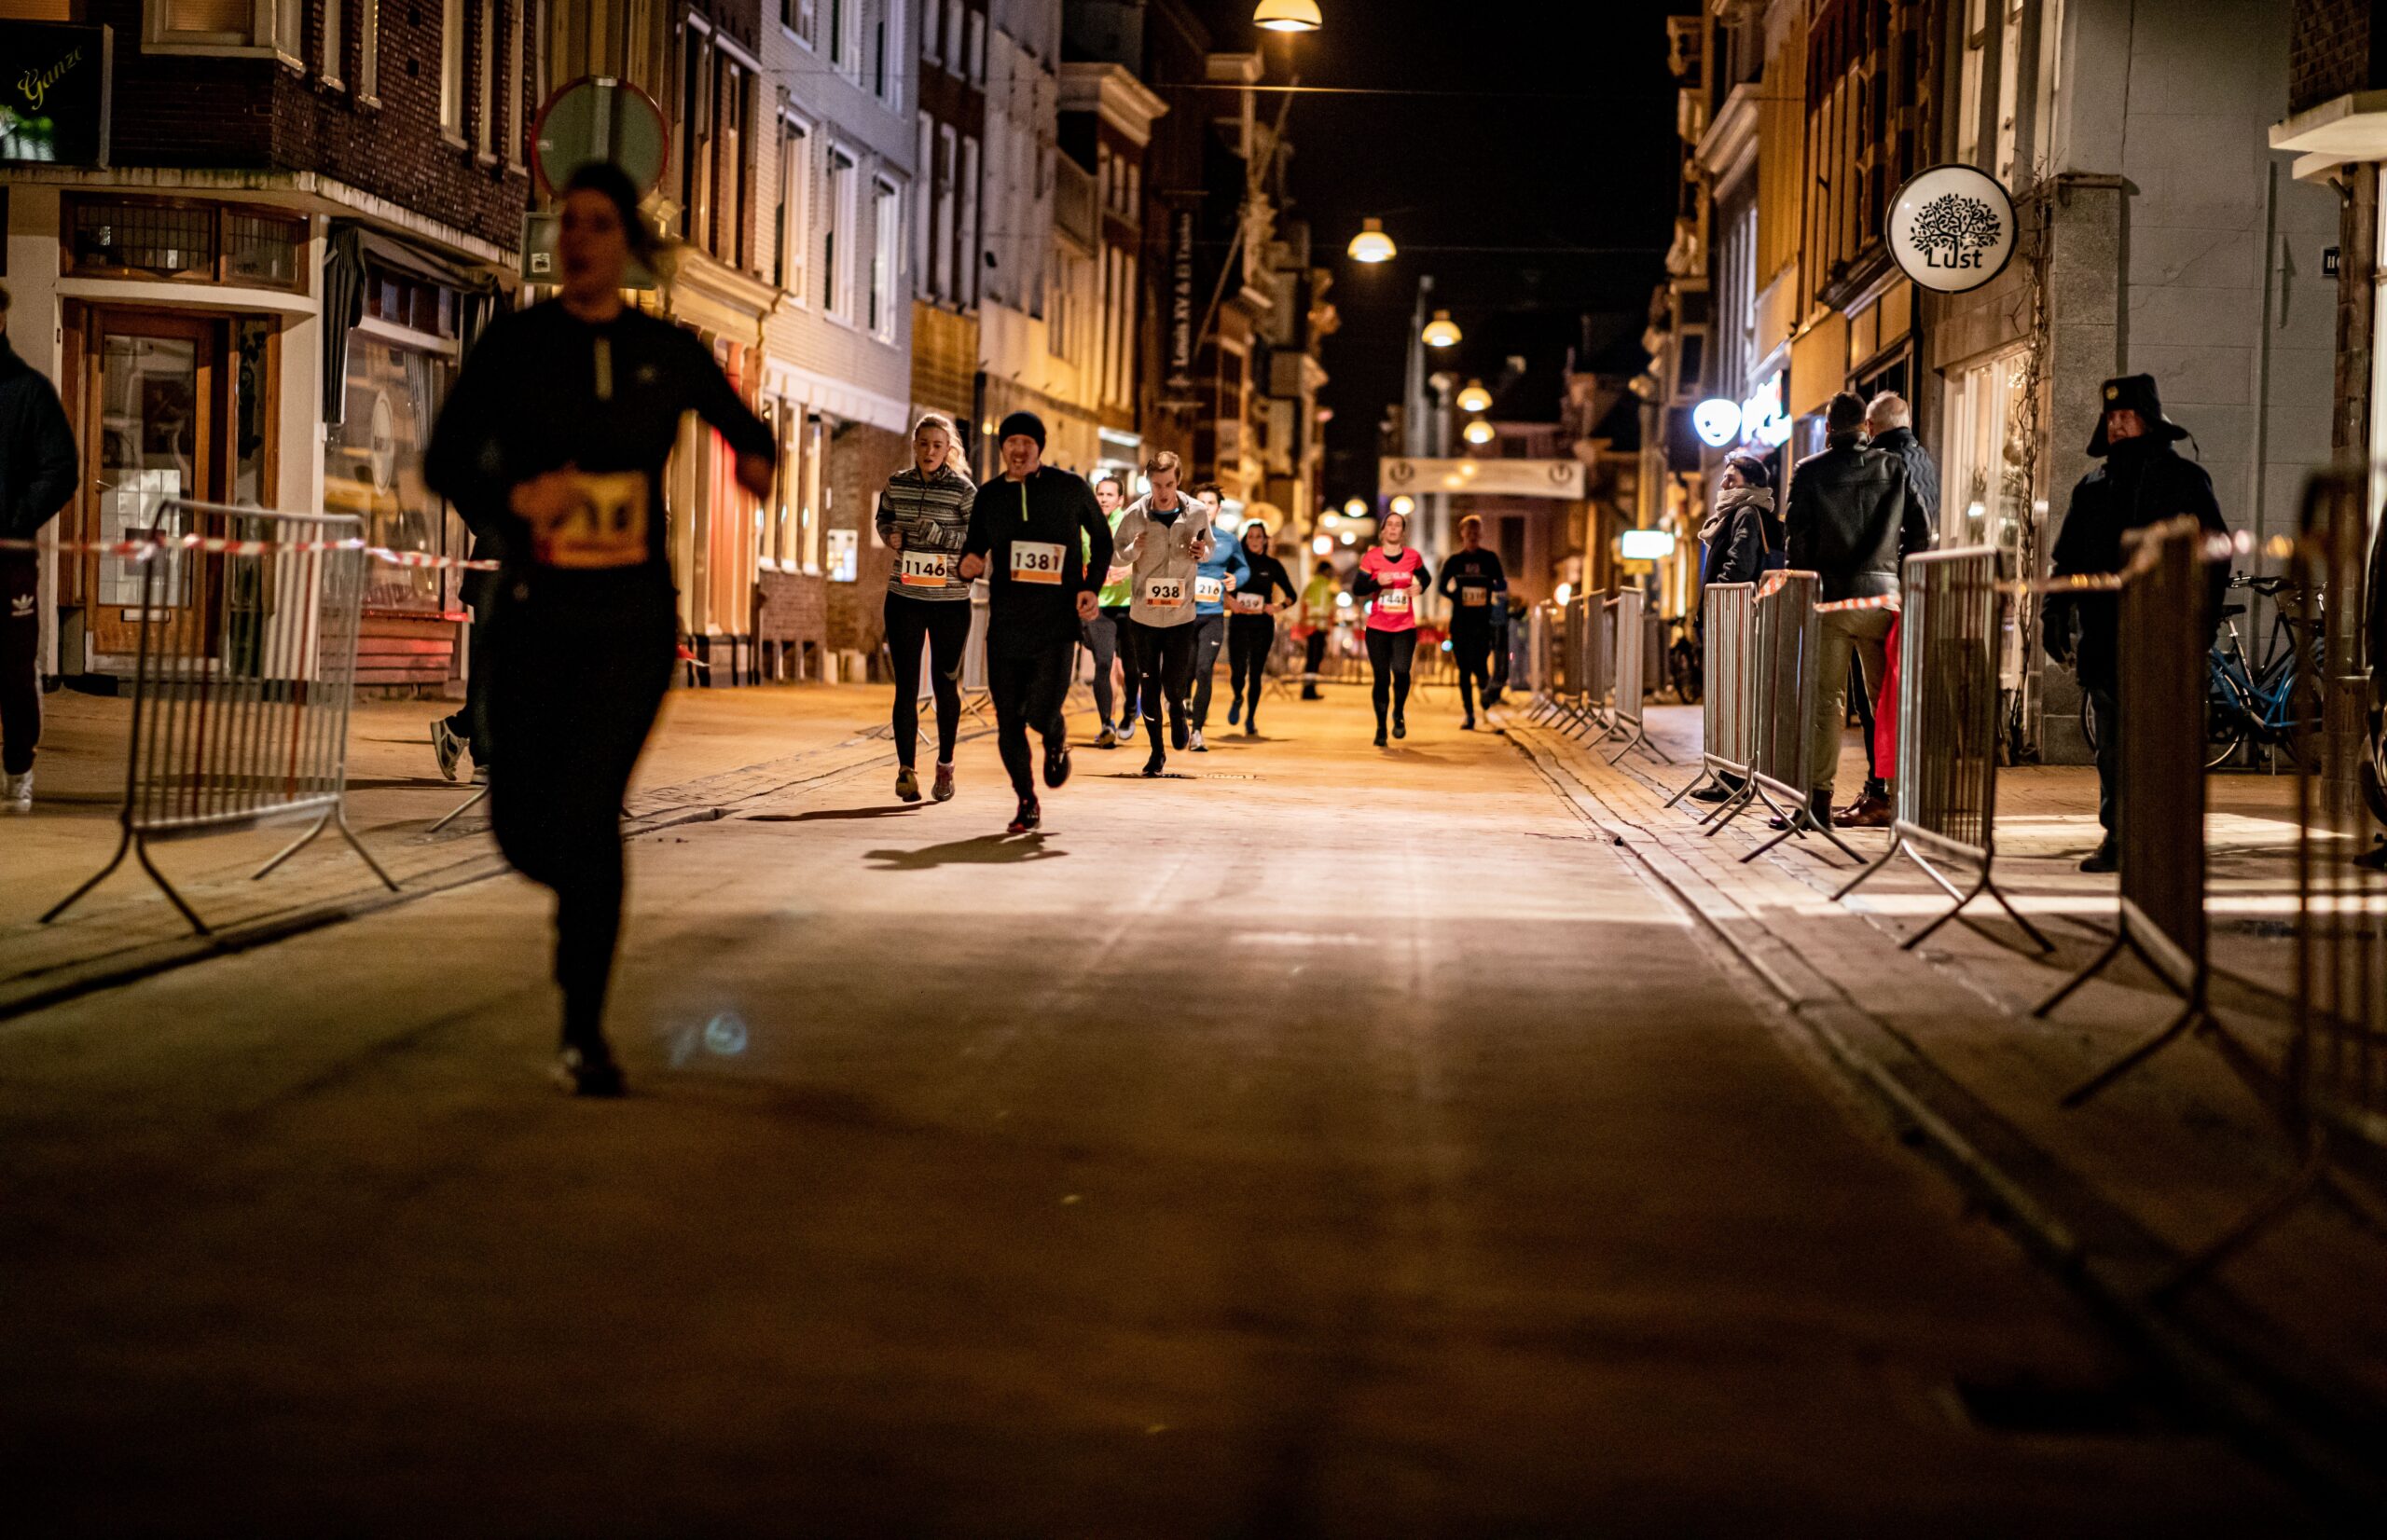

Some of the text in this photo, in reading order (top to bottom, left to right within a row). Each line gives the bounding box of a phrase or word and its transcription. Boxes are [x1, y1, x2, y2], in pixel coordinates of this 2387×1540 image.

[17, 45, 82, 110] Ganze
[1926, 247, 1983, 268] Lust
[904, 560, 945, 576] 1146
[1014, 552, 1059, 571] 1381
[1152, 585, 1180, 598] 938
